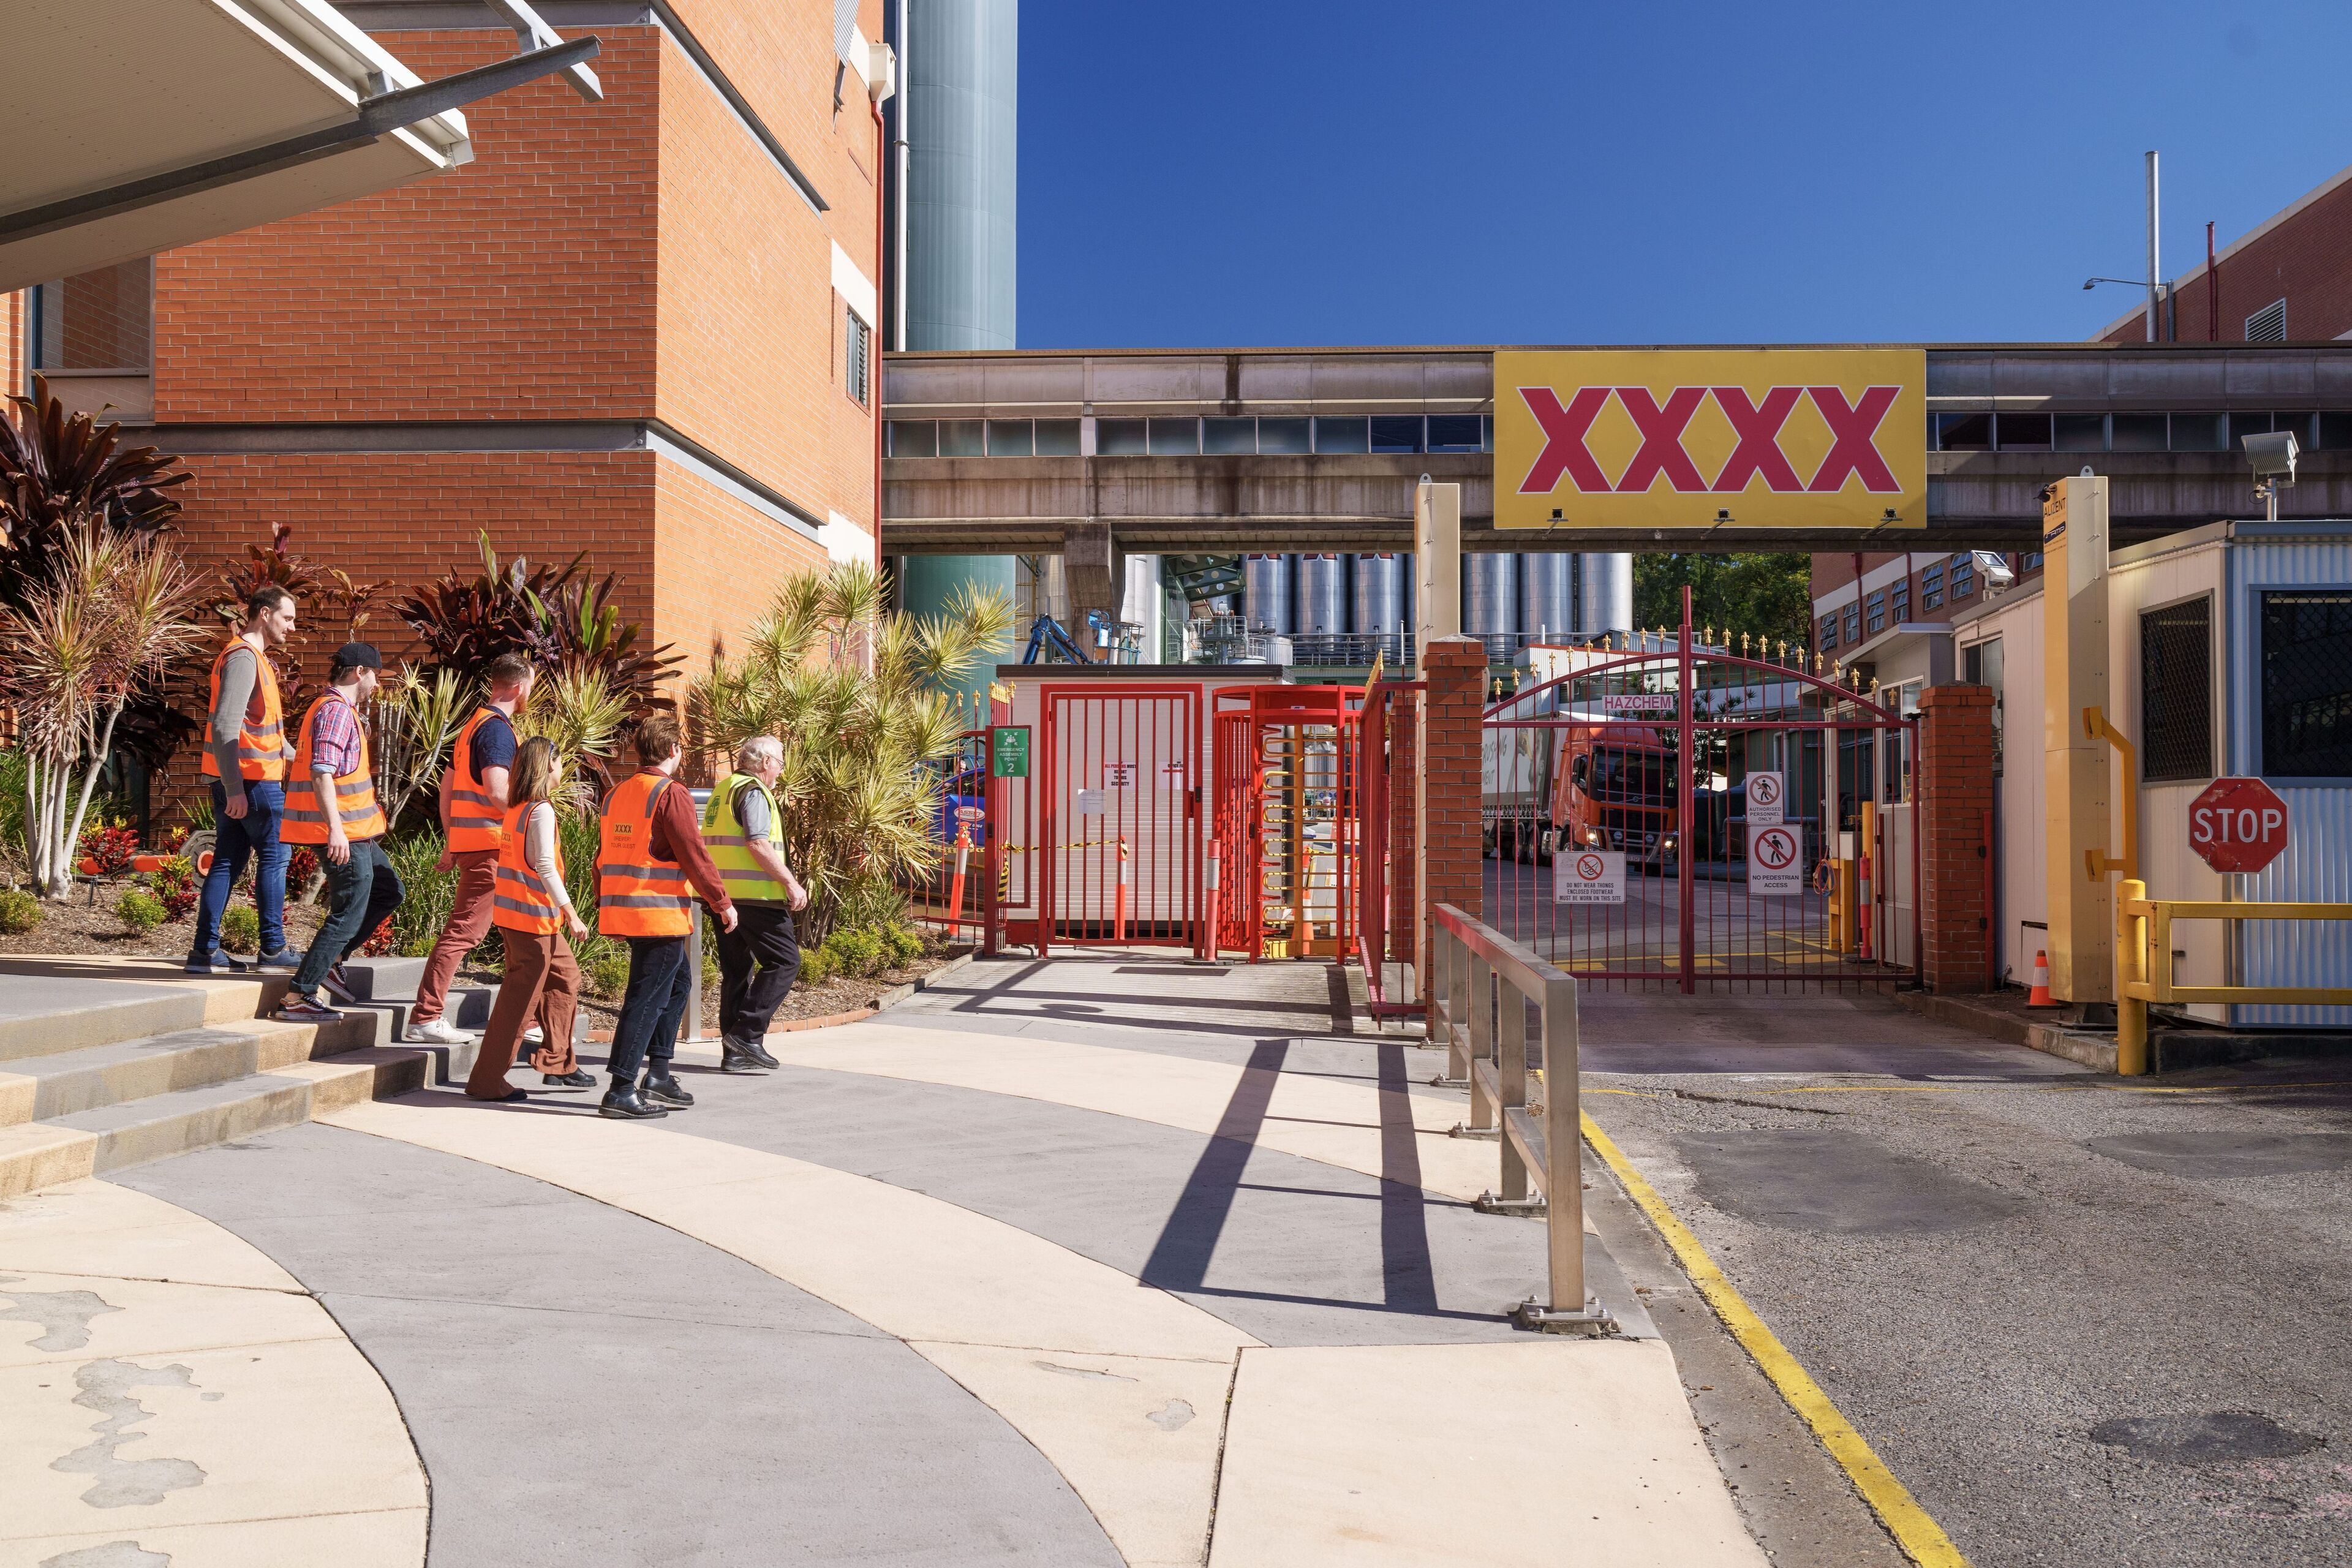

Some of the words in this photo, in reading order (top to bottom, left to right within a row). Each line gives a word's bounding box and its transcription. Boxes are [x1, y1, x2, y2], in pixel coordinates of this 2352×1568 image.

[1515, 385, 1904, 494] XXXX
[1604, 696, 1671, 709] HAZCHEM
[1008, 763, 1014, 772] 2
[614, 824, 632, 833] XXXX
[2194, 808, 2283, 843] STOP
